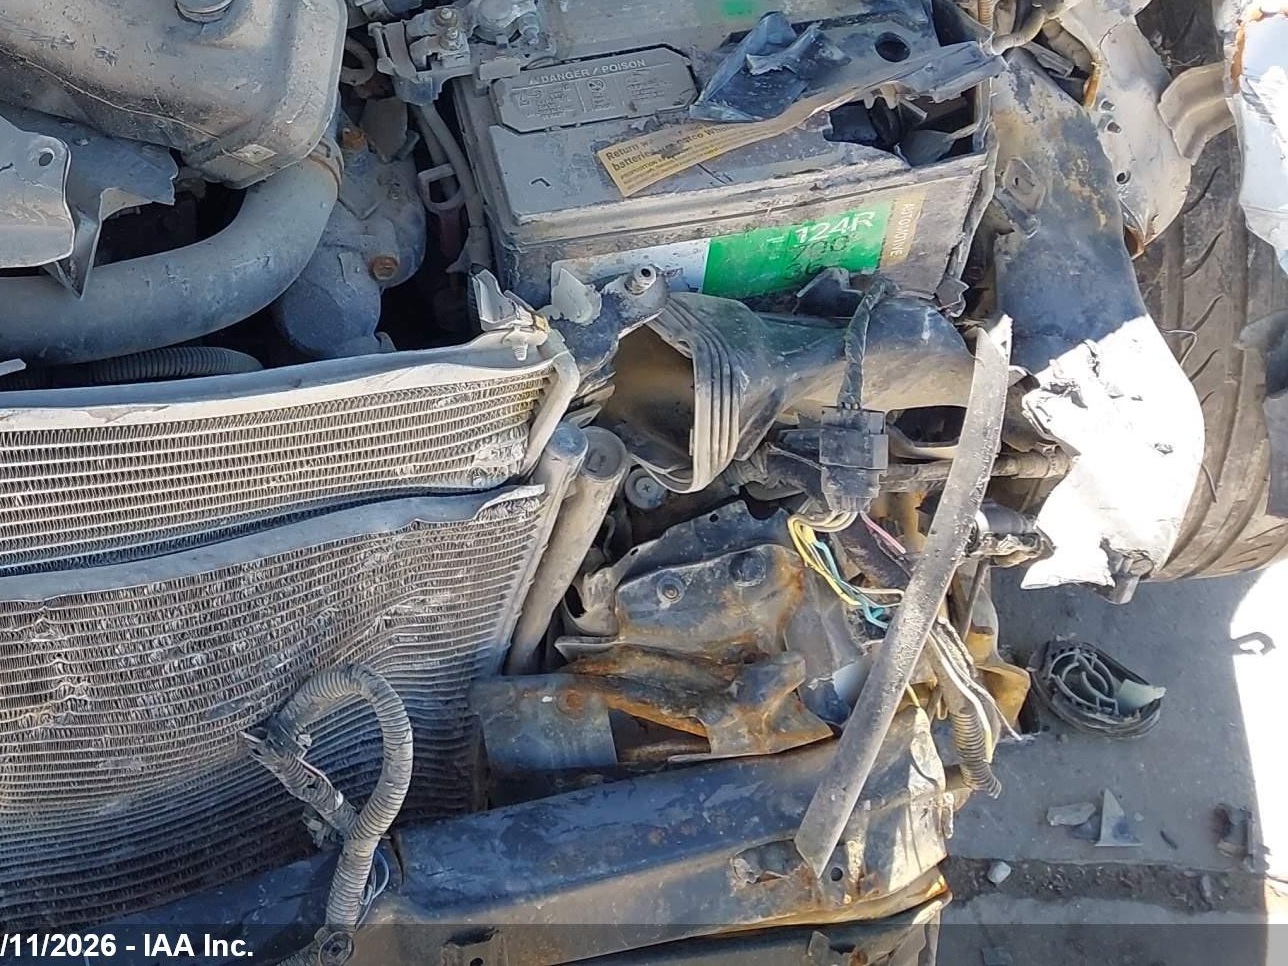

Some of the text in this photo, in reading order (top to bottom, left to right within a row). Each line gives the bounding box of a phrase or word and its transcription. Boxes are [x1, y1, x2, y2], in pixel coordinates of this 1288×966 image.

[540, 68, 591, 84] DANGER
[601, 58, 647, 74] POISON
[605, 143, 639, 161] Return
[795, 210, 876, 244] 124R
